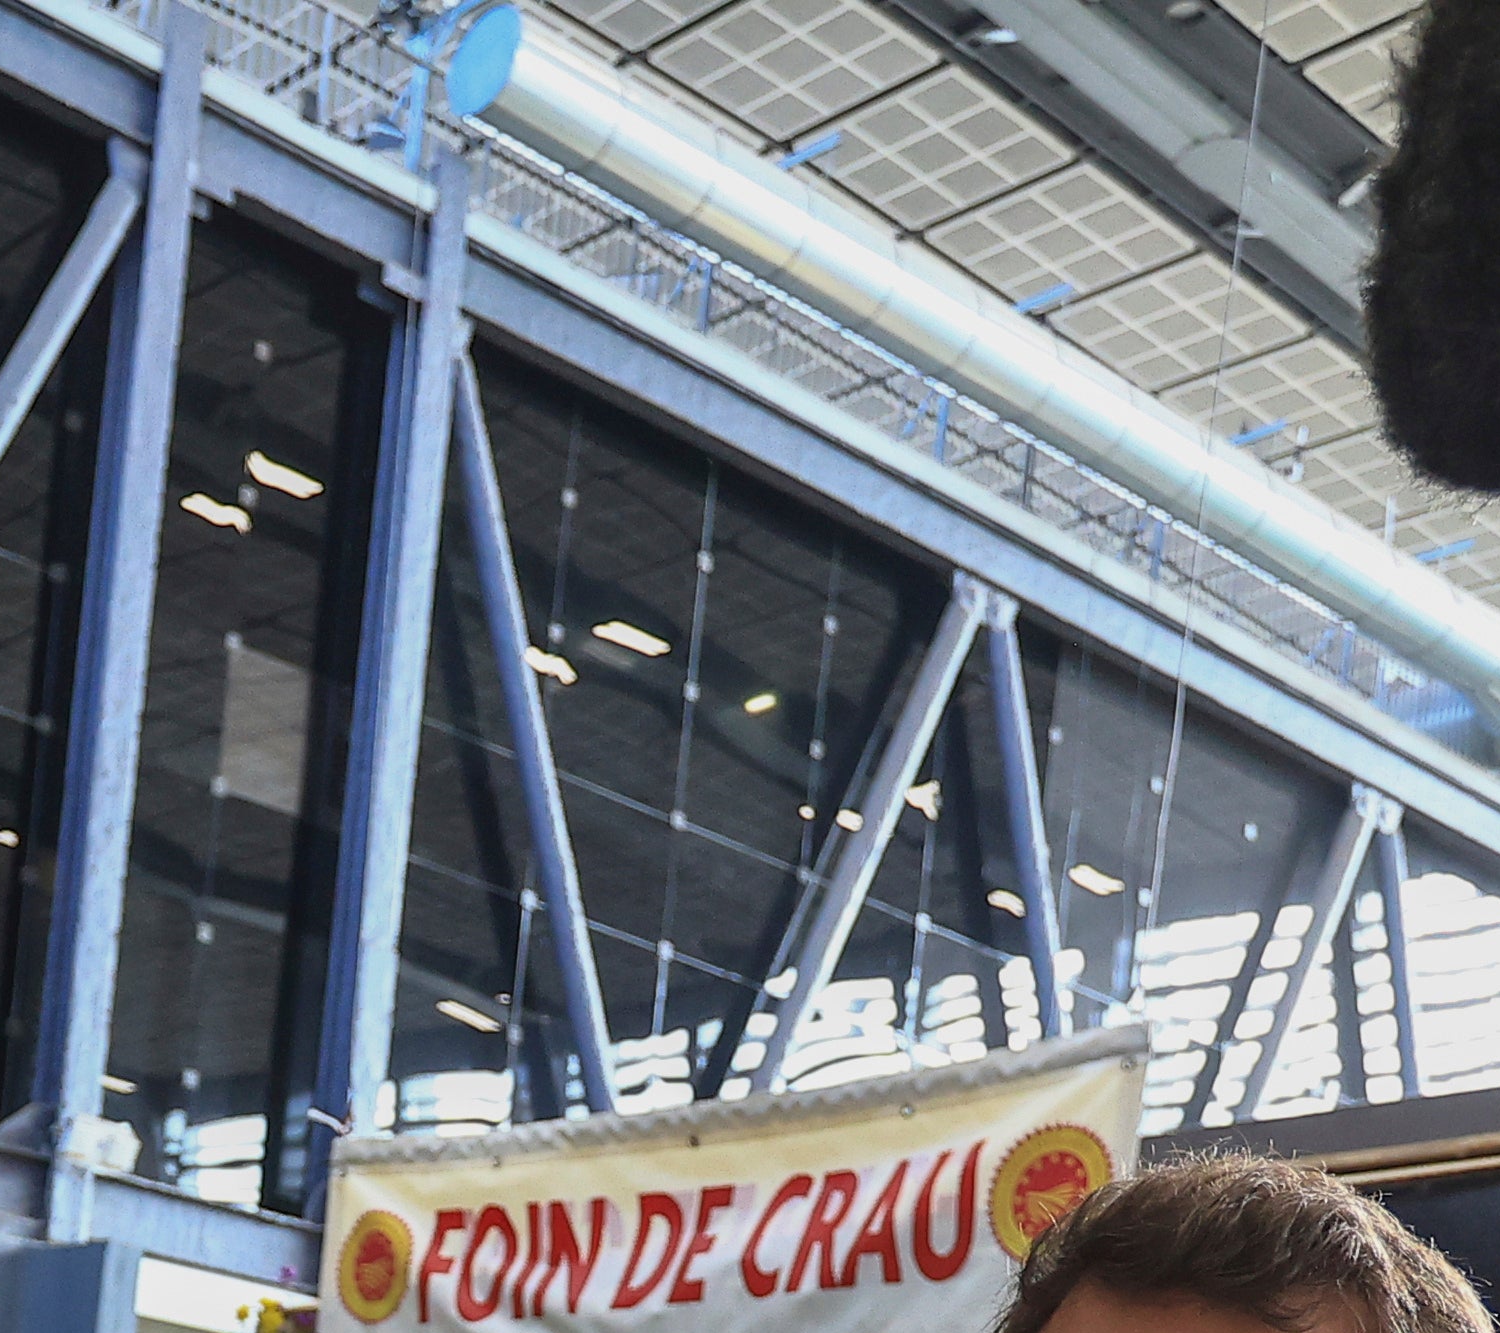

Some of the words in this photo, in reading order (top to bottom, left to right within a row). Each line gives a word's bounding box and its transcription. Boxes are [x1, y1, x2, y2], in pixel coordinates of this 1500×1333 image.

[418, 1195, 604, 1324] FOIN
[610, 1184, 737, 1310] DE
[740, 1140, 985, 1298] CRAU
